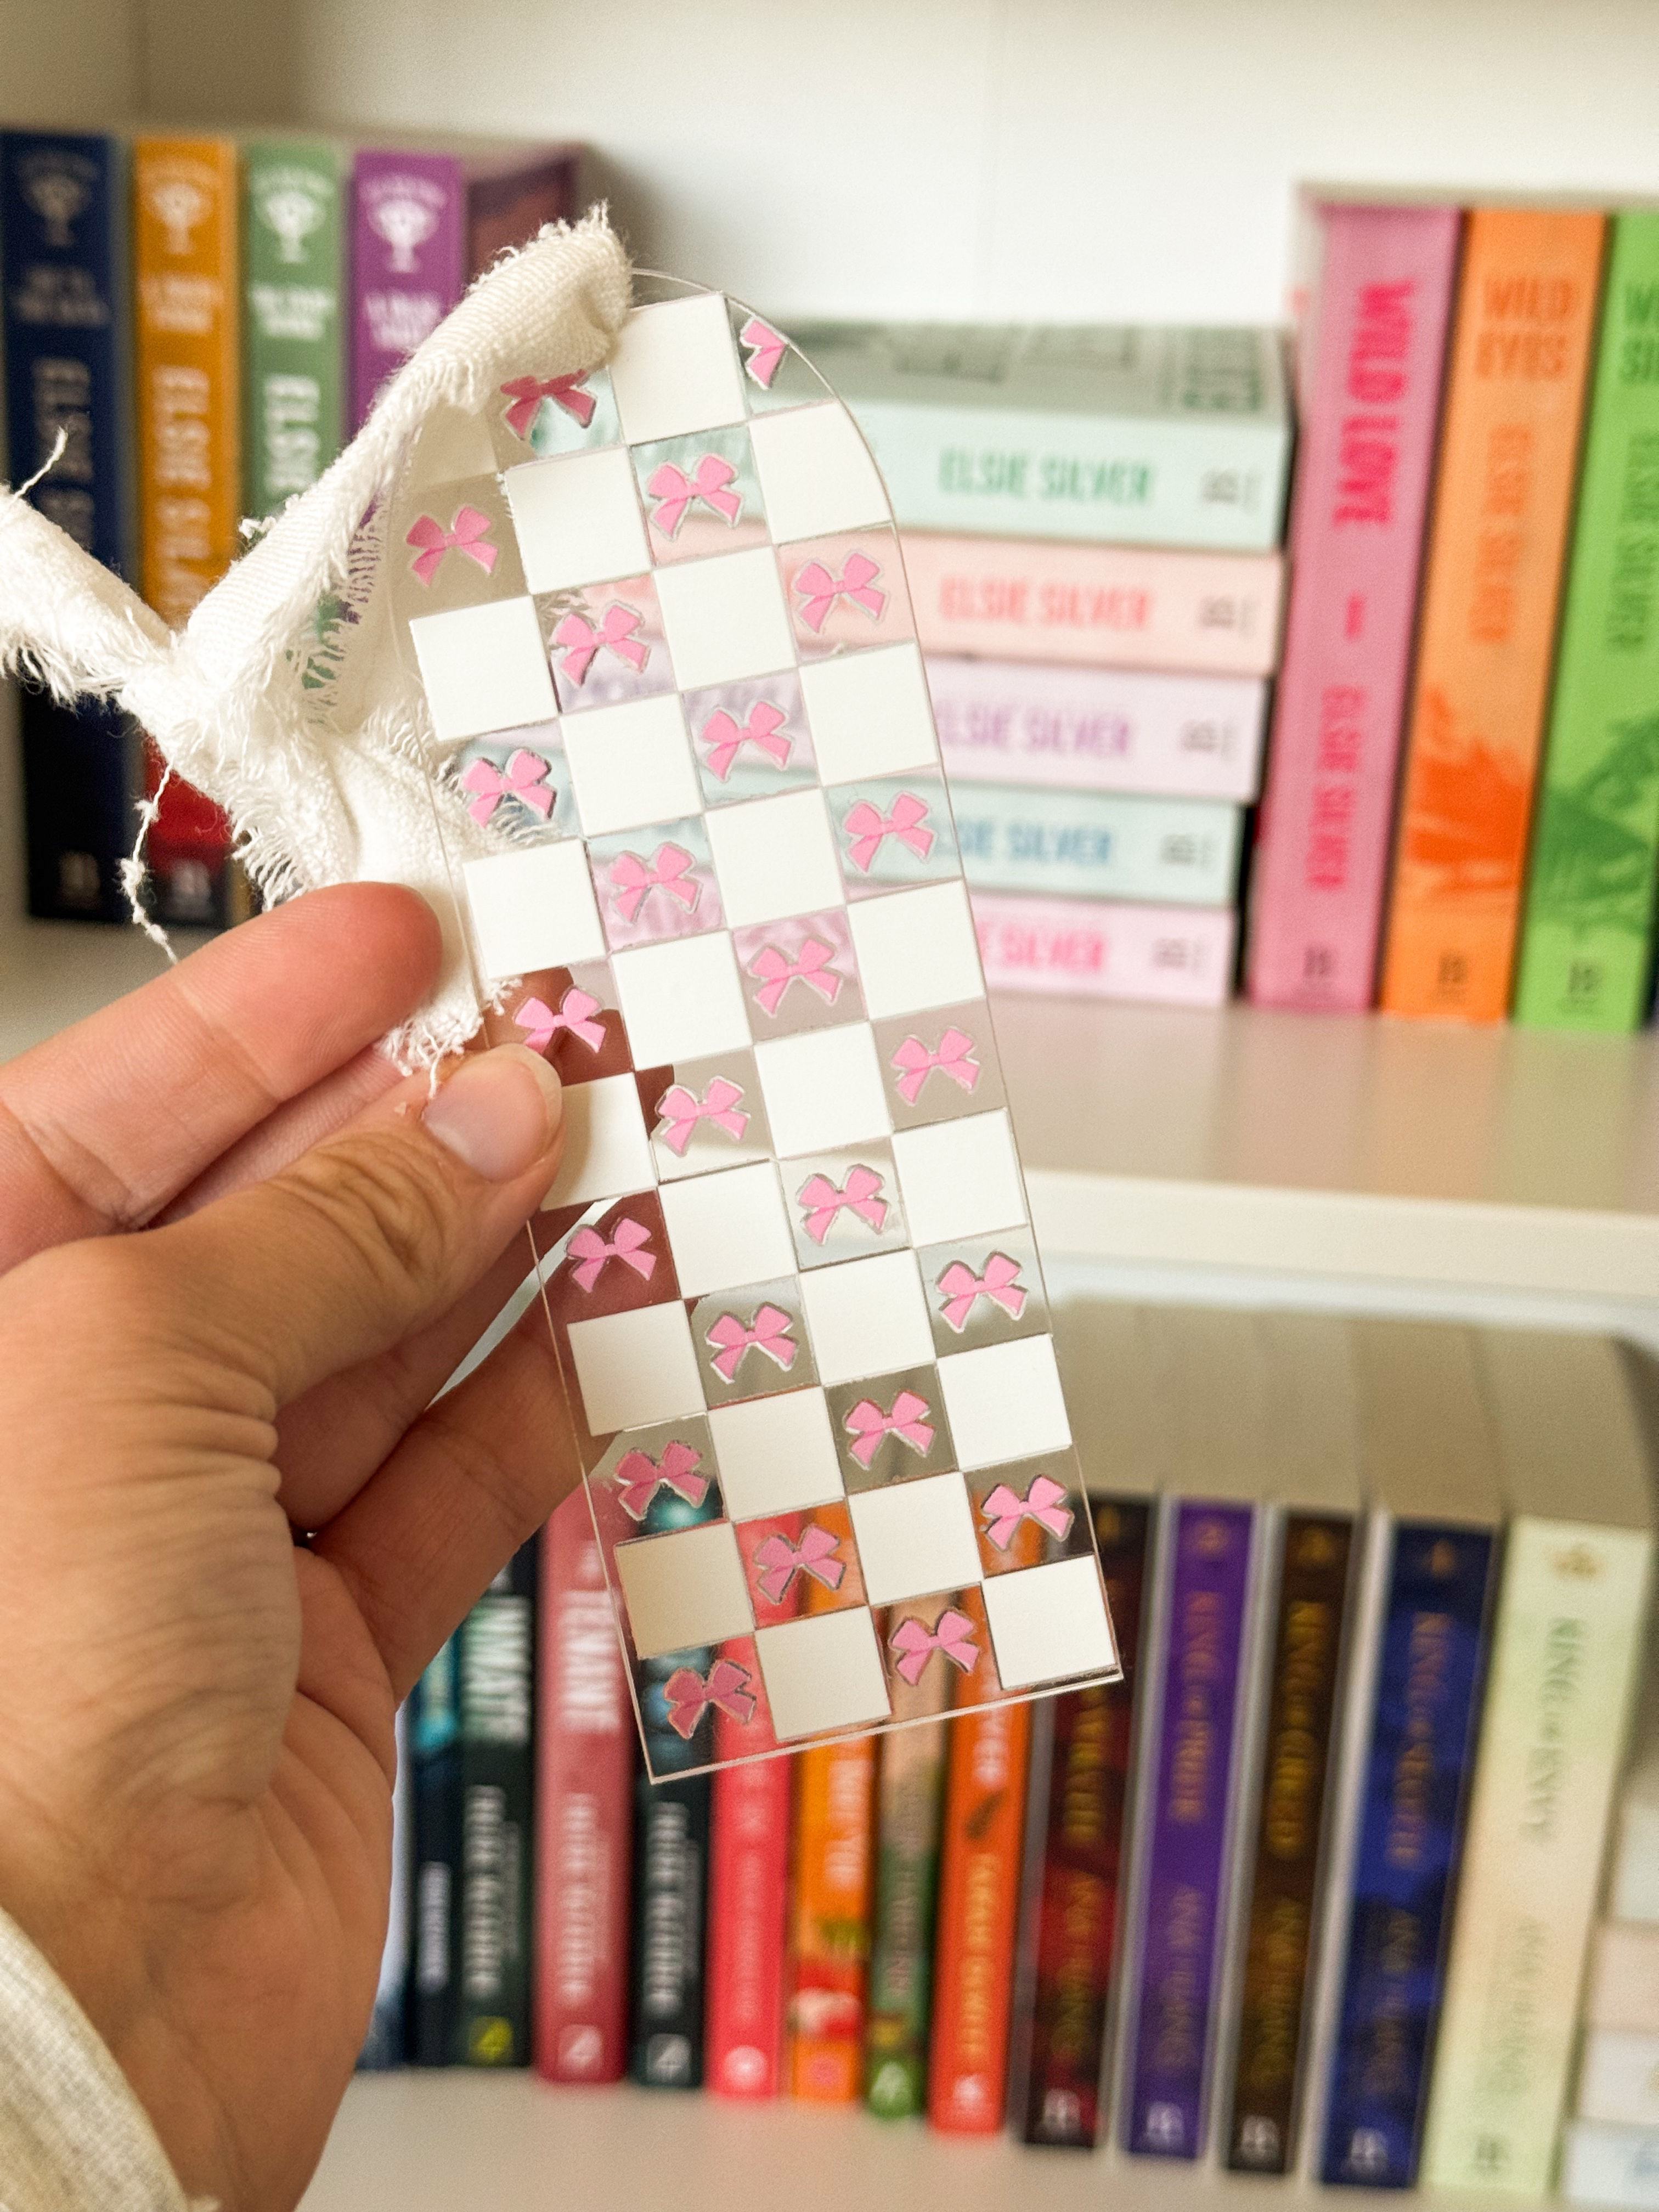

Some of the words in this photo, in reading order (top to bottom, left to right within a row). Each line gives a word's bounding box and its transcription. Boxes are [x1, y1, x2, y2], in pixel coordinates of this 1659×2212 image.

[1347, 279, 1417, 405] WILD
[939, 447, 1029, 498] ELSIE
[1040, 454, 1155, 507] SILVER
[1329, 414, 1404, 531] LOVE
[939, 575, 1029, 625] ELSIE
[1040, 583, 1153, 631] SILVER
[1023, 707, 1132, 759] SILVER
[1007, 819, 1114, 867] SILVER
[1000, 922, 1106, 974] SILVER
